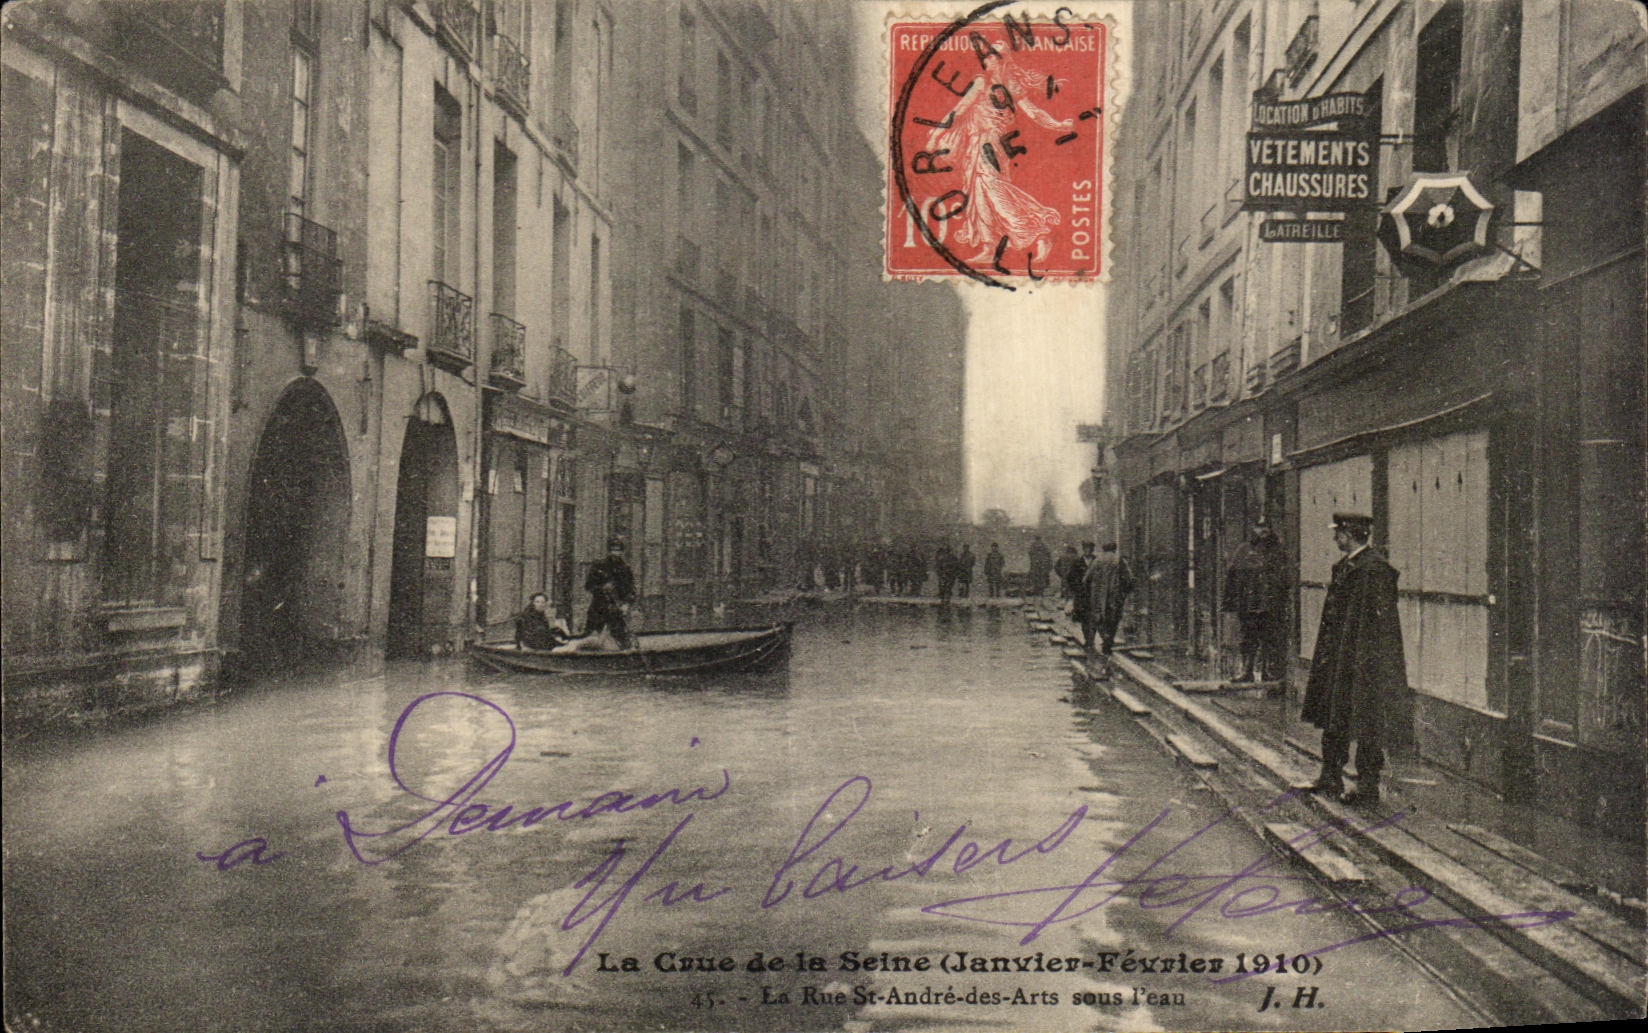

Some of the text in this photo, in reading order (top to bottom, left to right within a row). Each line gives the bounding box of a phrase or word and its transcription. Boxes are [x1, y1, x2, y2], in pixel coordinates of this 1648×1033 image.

[900, 34, 986, 52] REPLIQ
[1253, 103, 1309, 125] LOCATION
[1250, 172, 1369, 198] CHAUSSURES
[1071, 180, 1092, 260] POSTES
